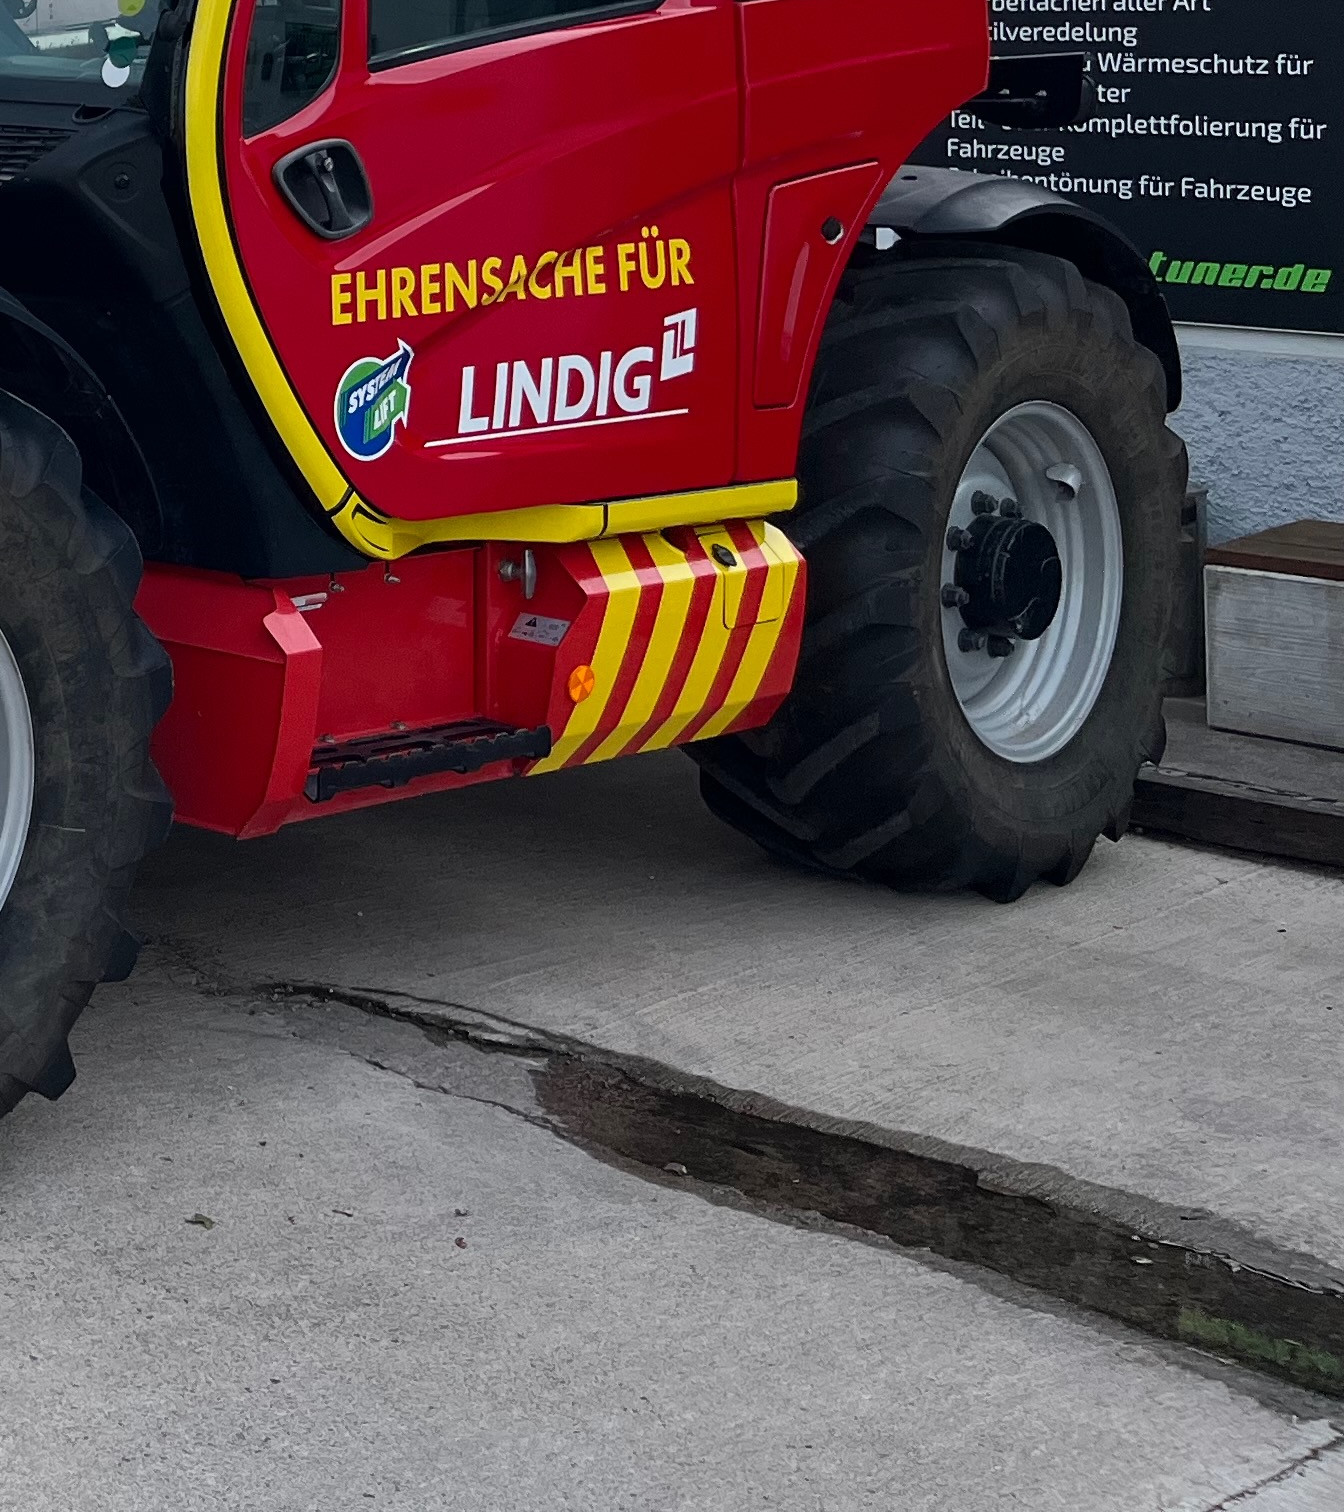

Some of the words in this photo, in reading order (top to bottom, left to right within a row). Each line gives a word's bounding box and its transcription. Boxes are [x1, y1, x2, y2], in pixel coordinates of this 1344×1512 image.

[1097, 52, 1270, 76] Wärmeschutz
[1275, 53, 1314, 76] für
[1059, 113, 1283, 144] mplettfolierung
[1288, 117, 1328, 140] für
[947, 138, 1066, 166] Fahrzeuge
[1138, 175, 1175, 197] für
[1180, 177, 1312, 208] Fahrzeuge
[330, 245, 606, 326] EHRENSACHE
[616, 225, 695, 293] FÜR
[348, 357, 403, 414] SYSTEM
[458, 345, 654, 434] LINDIG
[373, 389, 397, 431] LIFT
